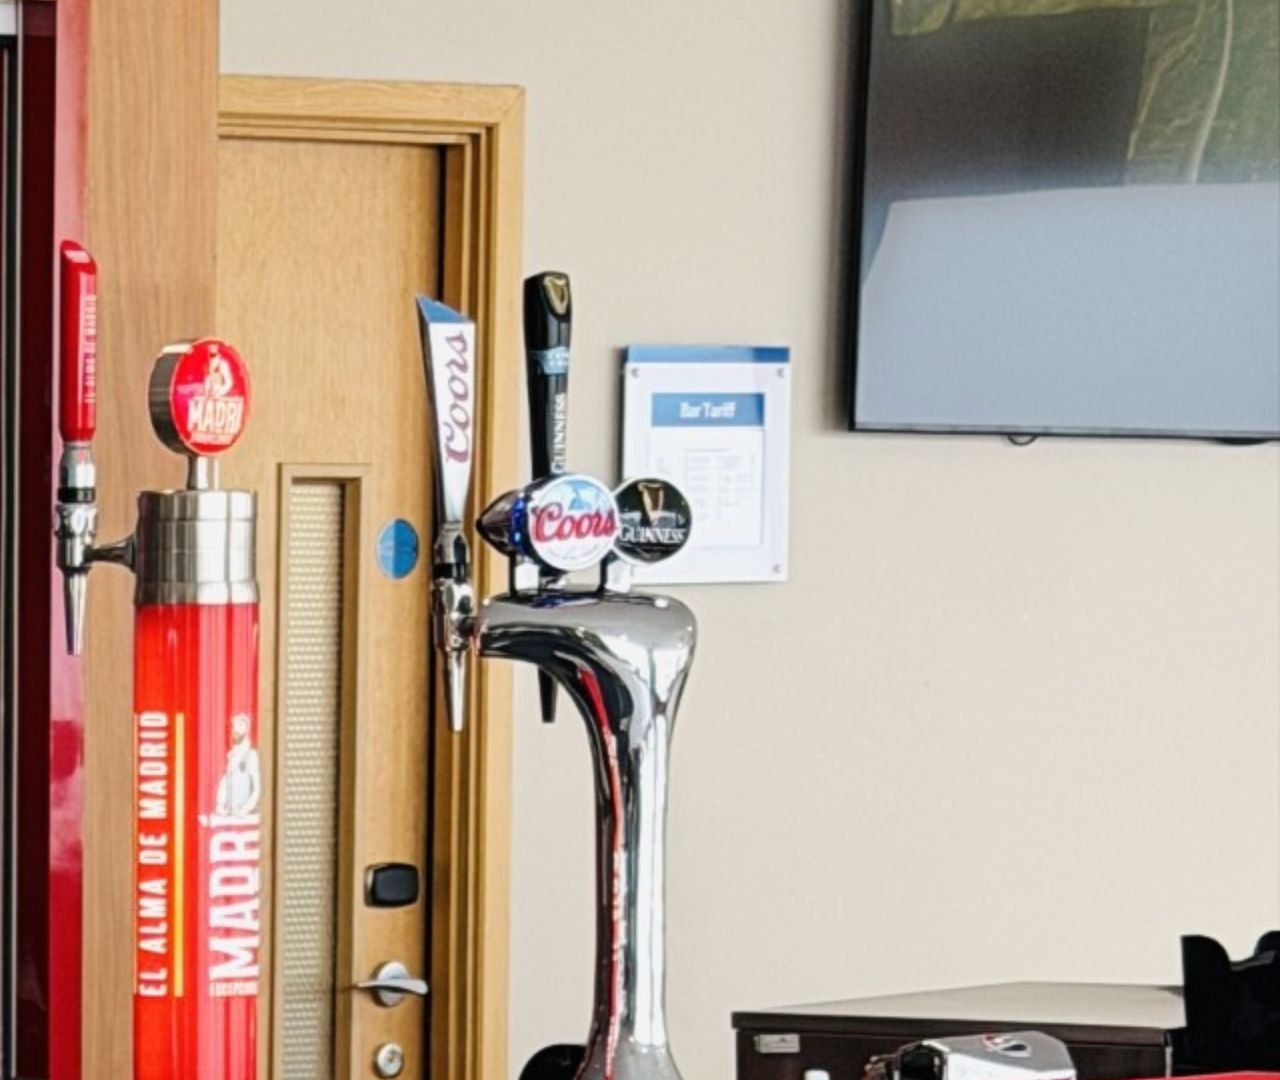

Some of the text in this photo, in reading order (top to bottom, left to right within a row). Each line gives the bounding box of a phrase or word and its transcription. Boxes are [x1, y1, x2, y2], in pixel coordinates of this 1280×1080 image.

[444, 331, 471, 464] Coors
[680, 402, 736, 418] Bar Tariff
[550, 393, 567, 472] GUINNESS
[531, 503, 618, 543] Coors
[619, 524, 688, 544] GUINNESS
[138, 711, 169, 998] EL ALMA DE MADRID
